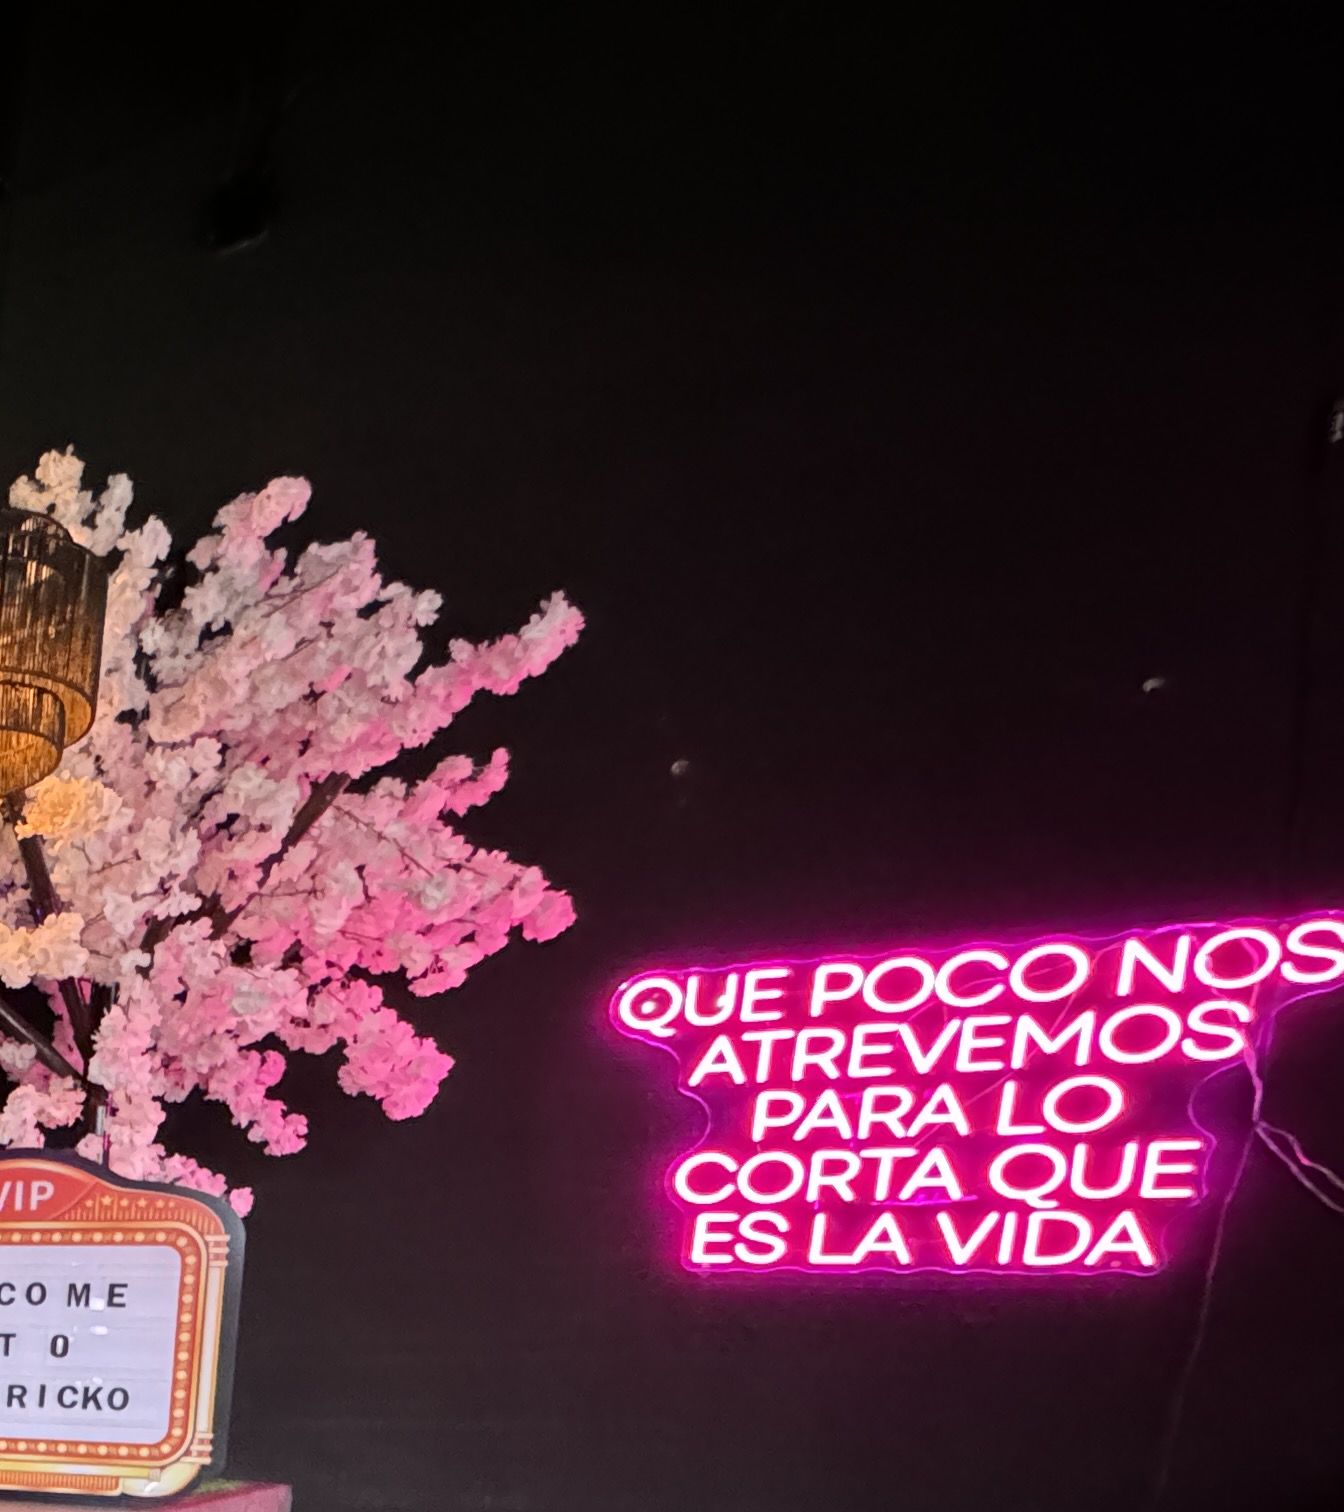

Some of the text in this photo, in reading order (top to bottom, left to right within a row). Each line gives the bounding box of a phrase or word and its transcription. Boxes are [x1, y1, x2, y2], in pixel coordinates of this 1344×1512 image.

[618, 920, 1344, 1037] QUE POCO NOS
[688, 1001, 1254, 1086] ATREVEMOS
[751, 1074, 1124, 1141] PARA LO
[674, 1139, 1202, 1209] CORTA QUE
[690, 1209, 1157, 1267] ES LA VIDA
[6, 1384, 130, 1411] RICKO
